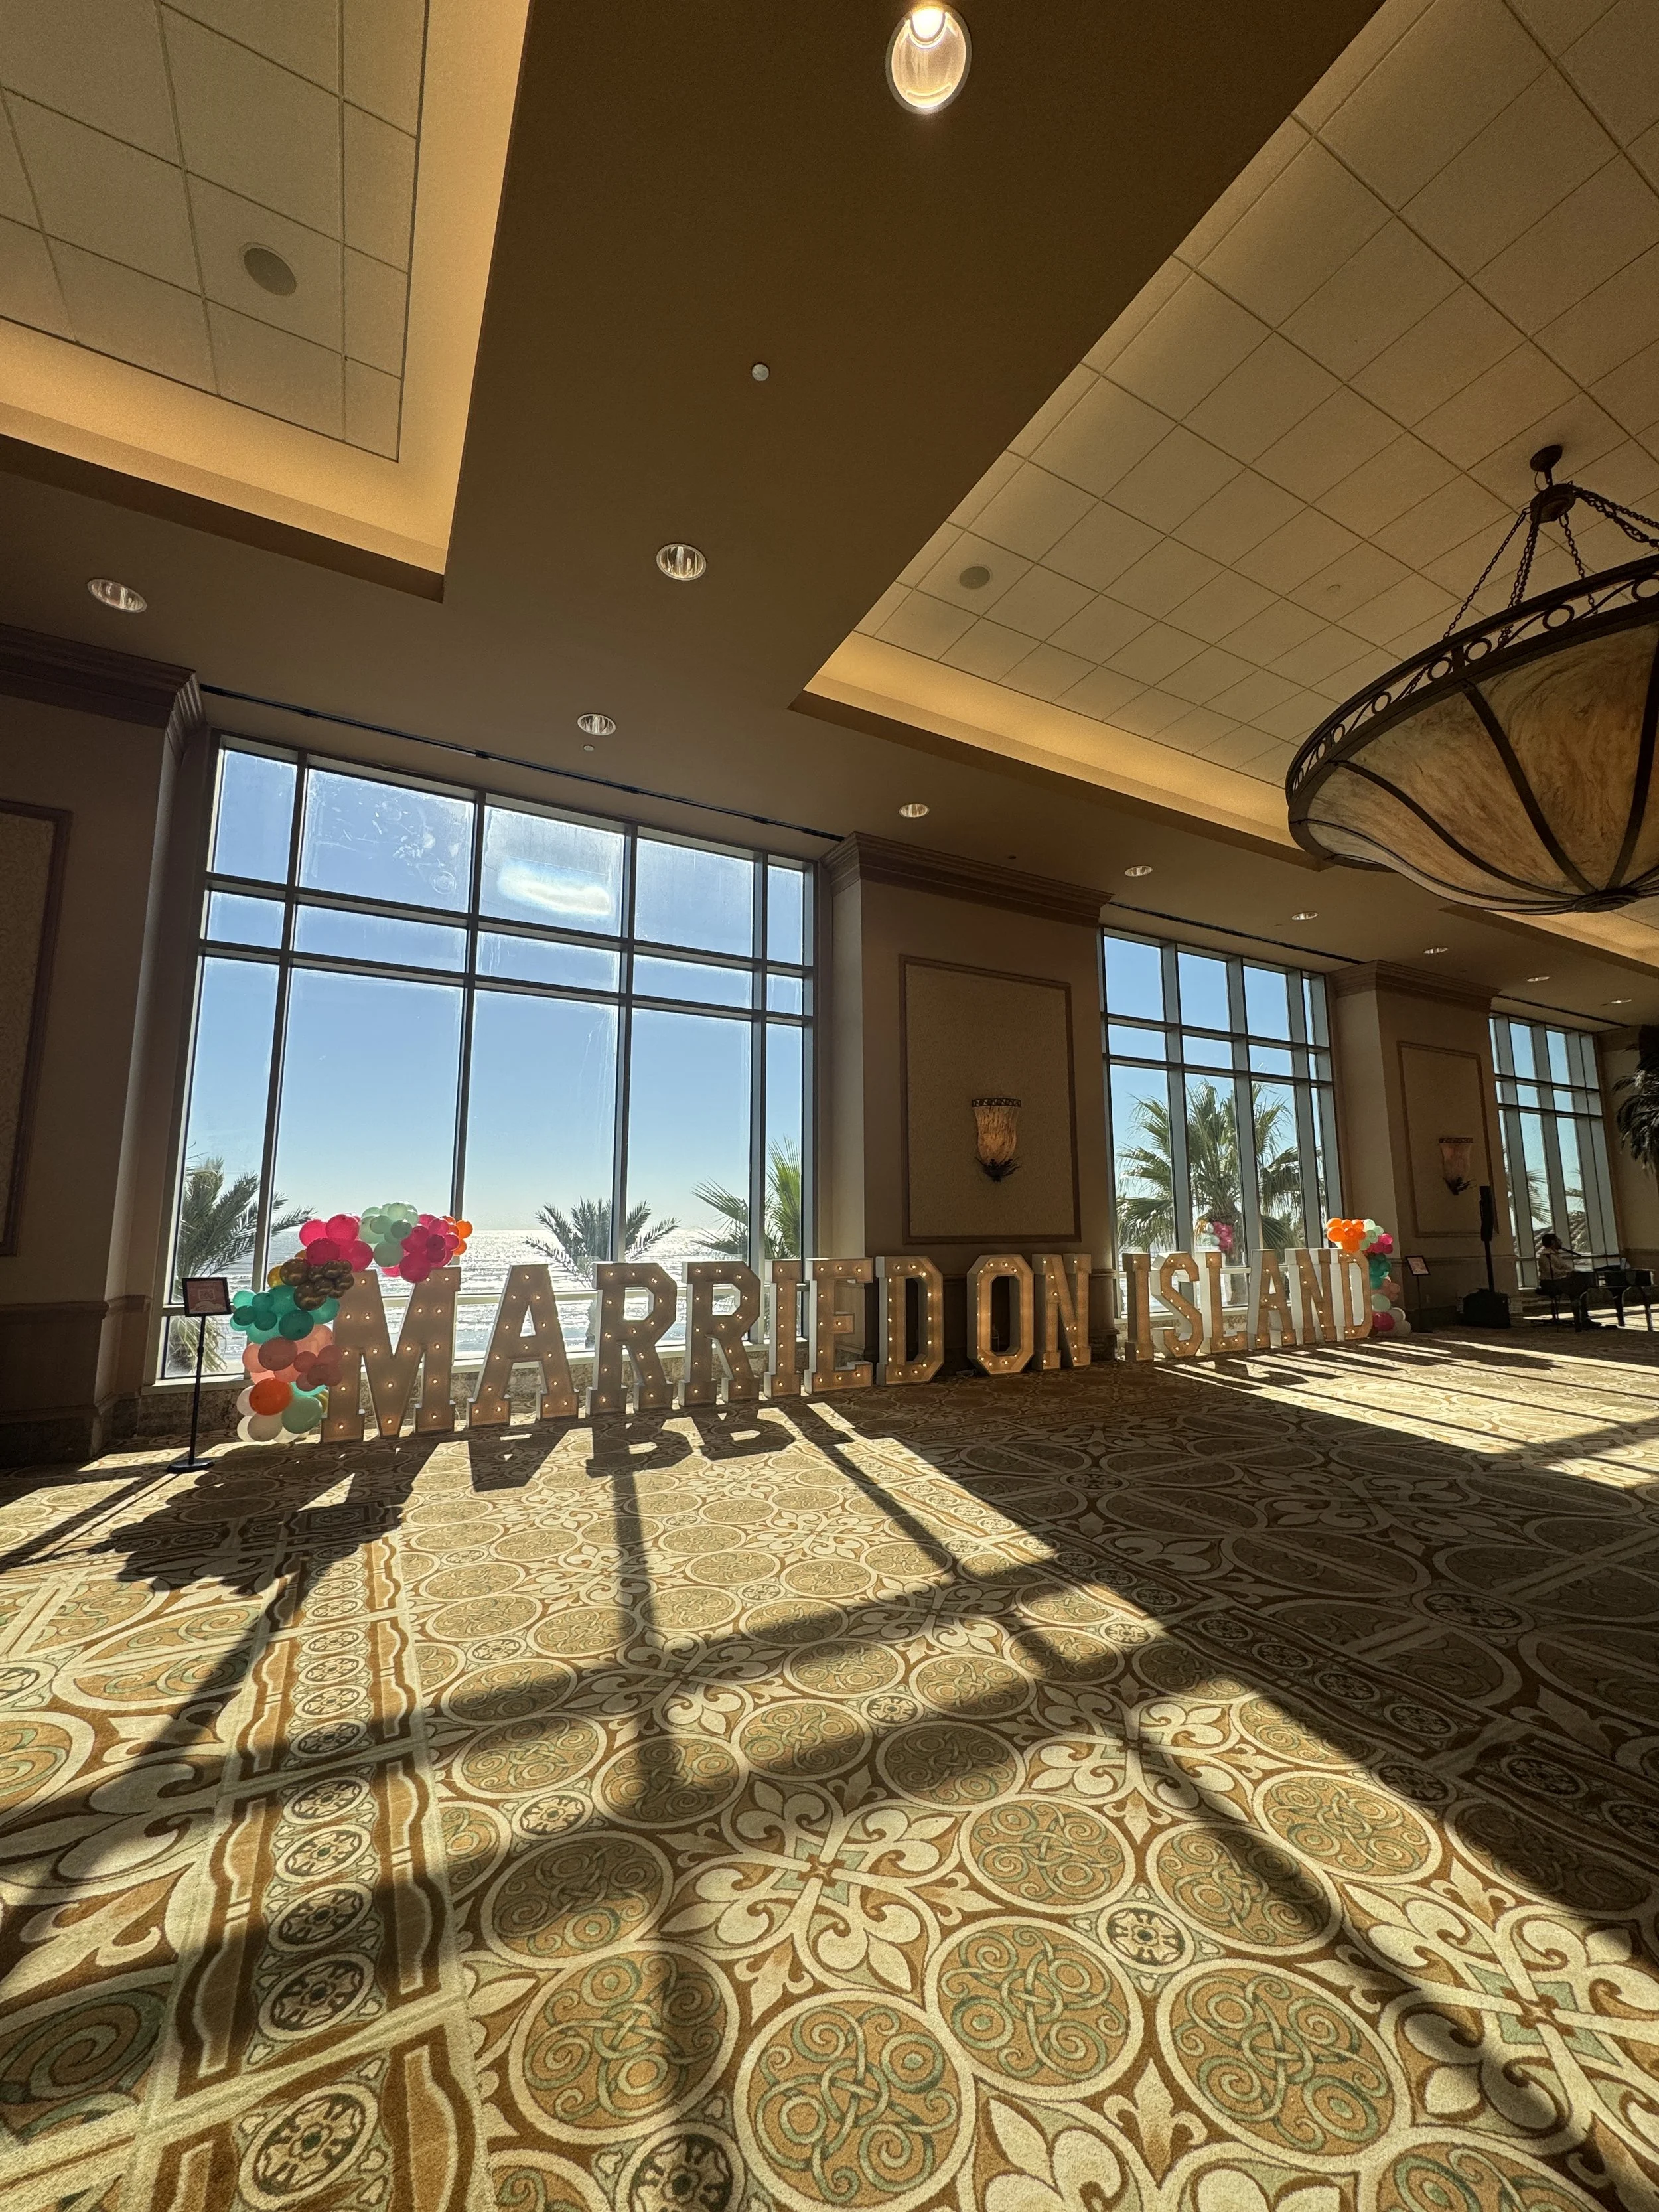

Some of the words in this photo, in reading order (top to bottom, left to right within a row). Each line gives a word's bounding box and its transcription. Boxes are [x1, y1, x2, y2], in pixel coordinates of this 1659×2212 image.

[322, 1256, 944, 1443] MARRIED
[967, 1254, 1090, 1375] ON
[1123, 1248, 1372, 1362] ISLAND
